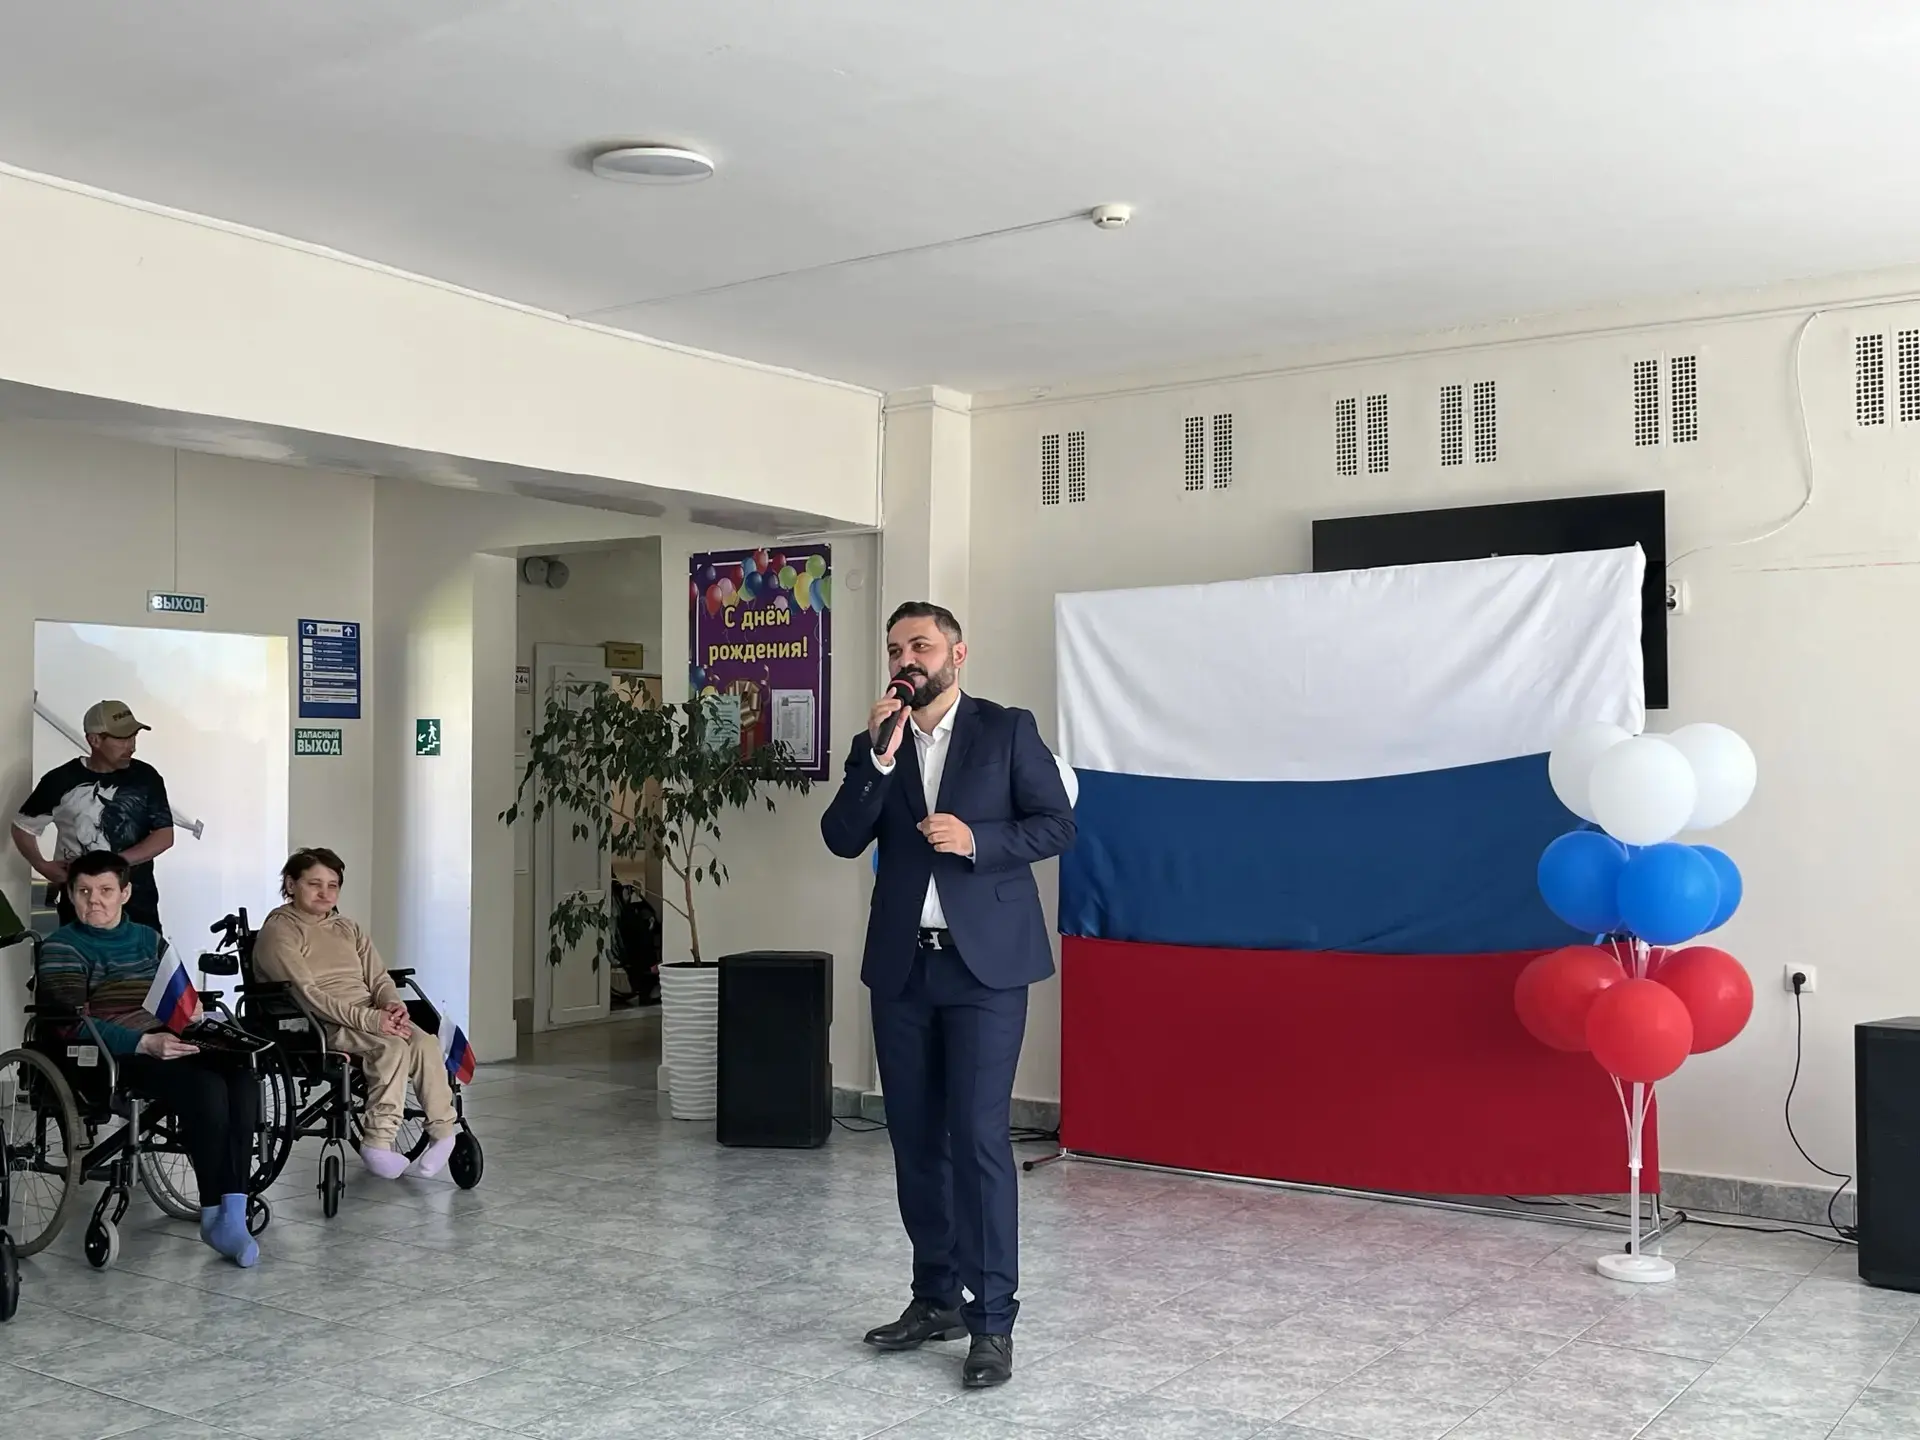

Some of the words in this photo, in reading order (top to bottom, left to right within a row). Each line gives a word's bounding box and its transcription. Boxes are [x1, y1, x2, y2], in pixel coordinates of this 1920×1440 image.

[152, 595, 202, 612] ВЫХОД
[724, 606, 736, 628] С
[741, 605, 790, 631] днём
[708, 635, 808, 666] рождения!
[297, 729, 340, 739] ЗАПАСНЫЙ
[297, 739, 341, 755] ВЫХОД
